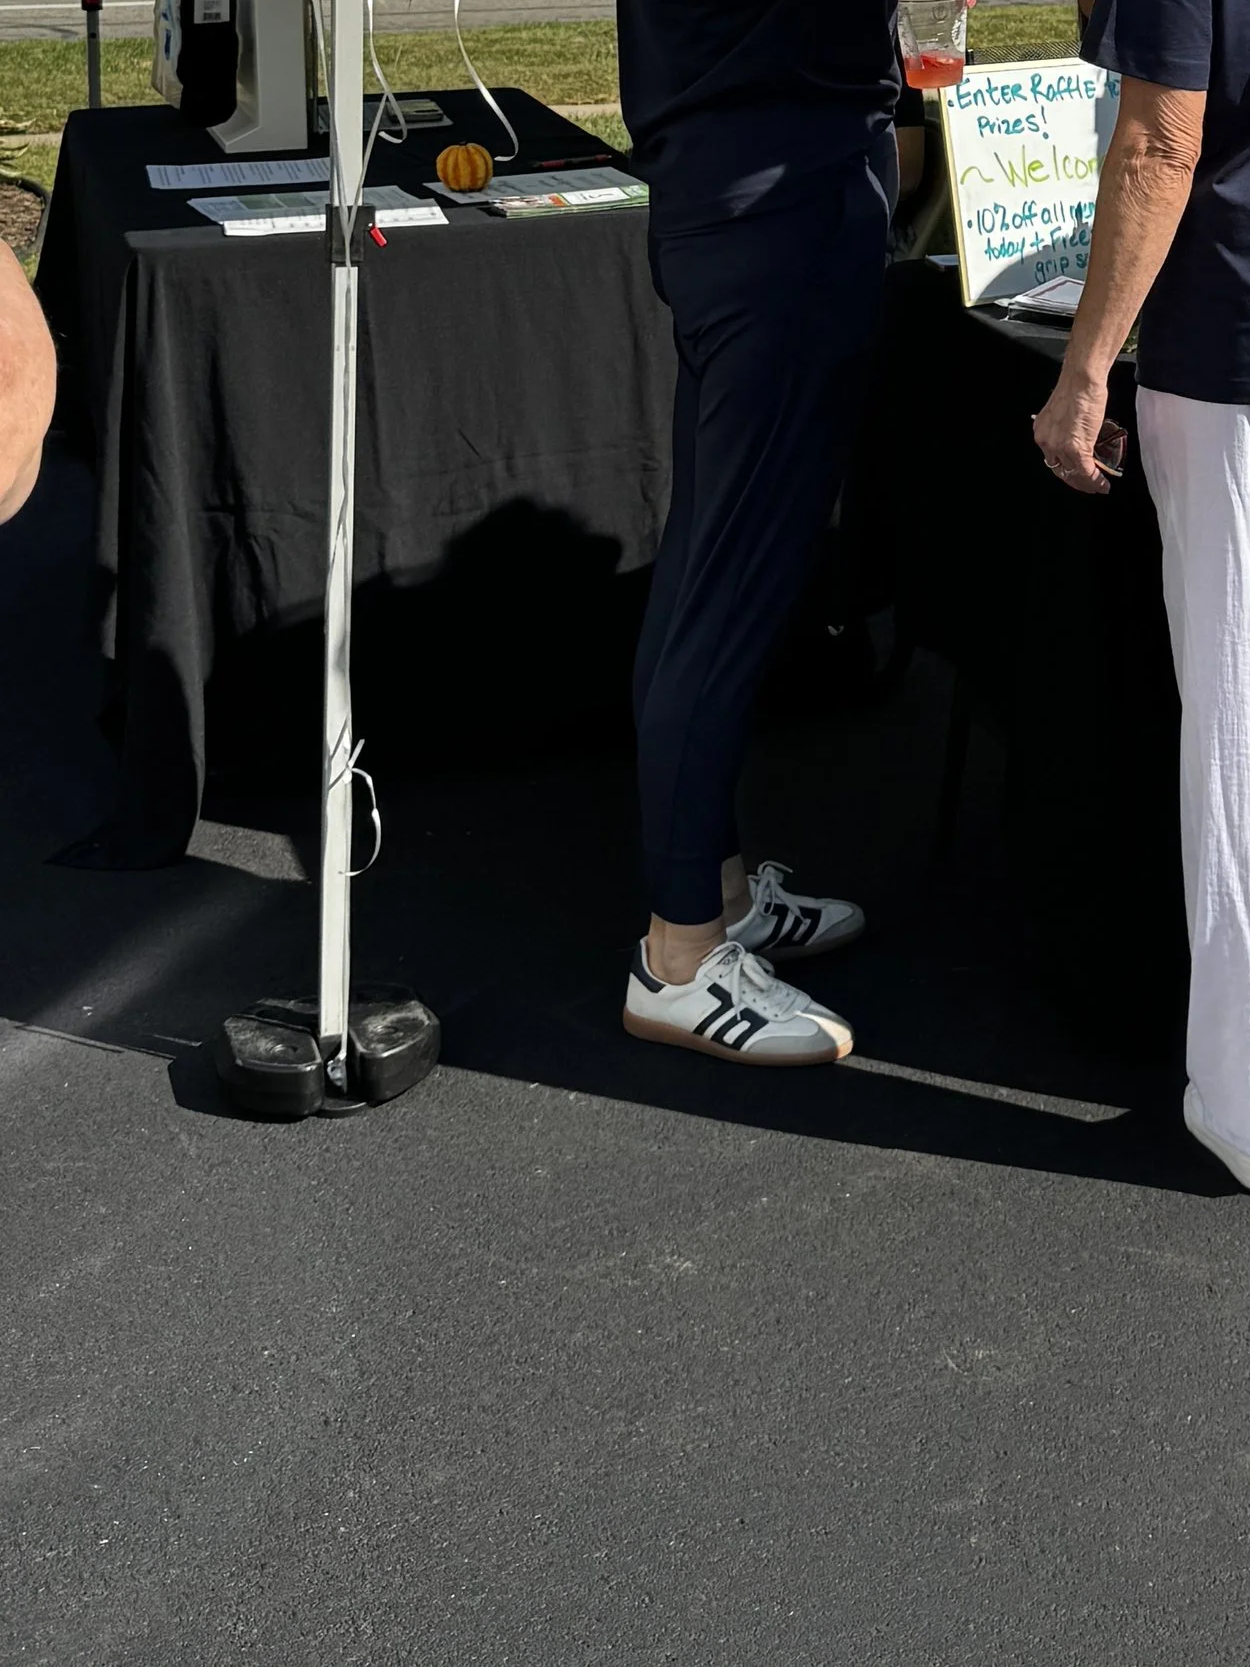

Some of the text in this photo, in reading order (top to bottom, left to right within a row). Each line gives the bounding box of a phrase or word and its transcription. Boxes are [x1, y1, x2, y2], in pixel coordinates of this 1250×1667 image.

[977, 201, 1010, 236] 10%
[1012, 200, 1038, 228] off
[1041, 200, 1066, 225] all
[984, 236, 1025, 265] today
[1049, 226, 1091, 253] Free
[1034, 255, 1070, 285] grip
